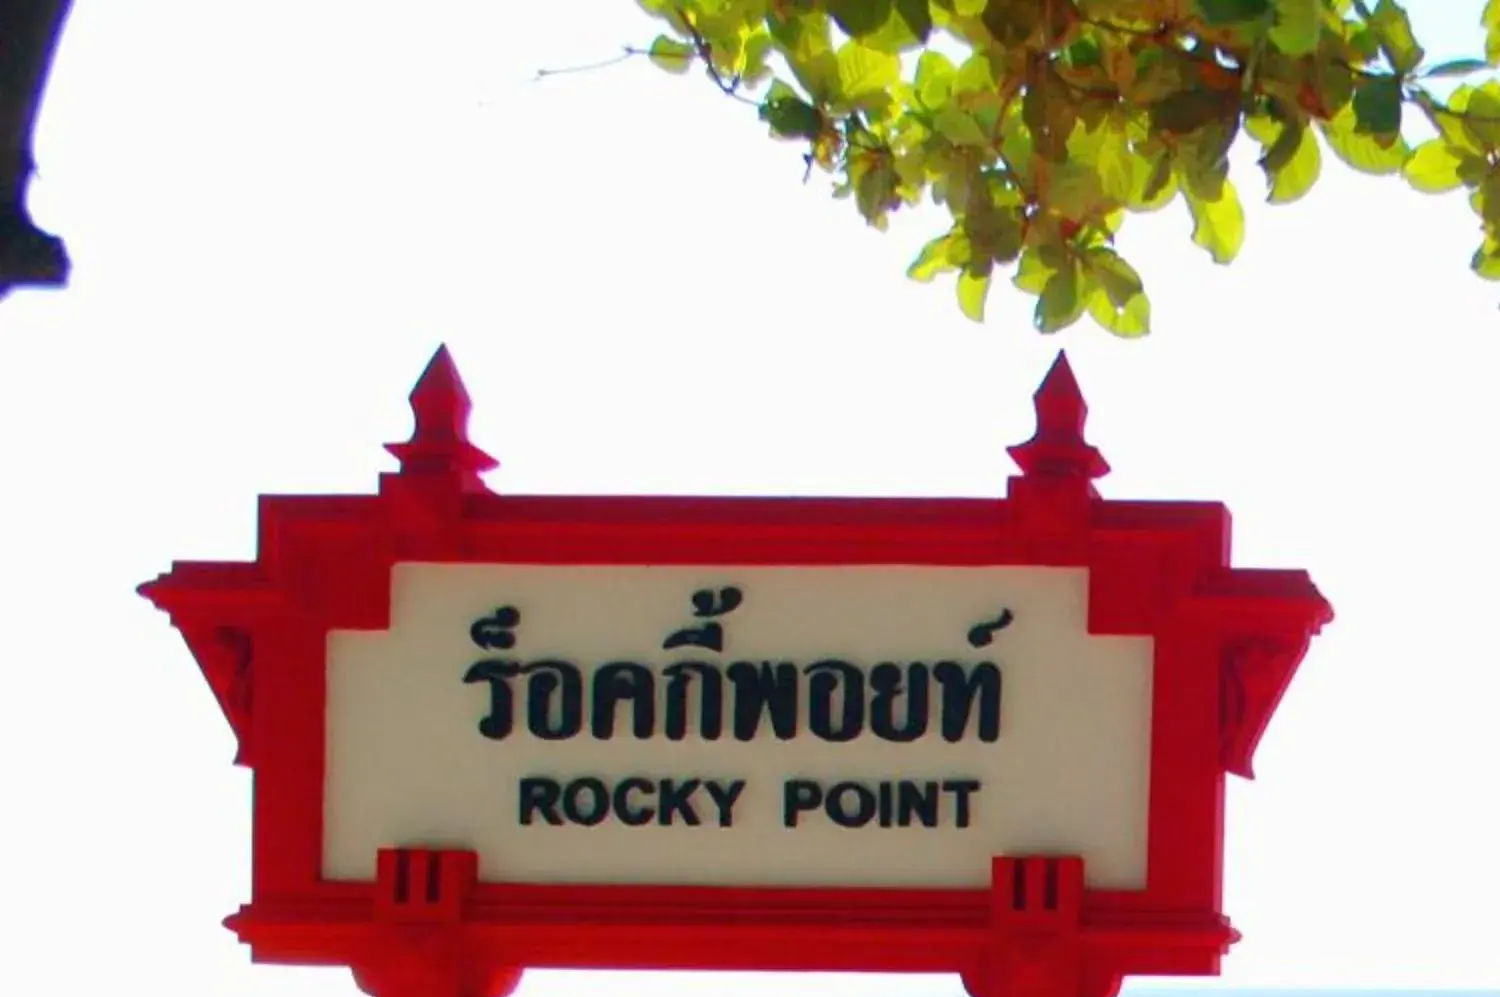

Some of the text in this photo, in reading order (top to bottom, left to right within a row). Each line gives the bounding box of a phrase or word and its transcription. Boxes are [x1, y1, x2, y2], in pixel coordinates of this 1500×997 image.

[462, 586, 1014, 743] ร็อคกี้พอยท์
[518, 776, 982, 829] ROCKY POINT
